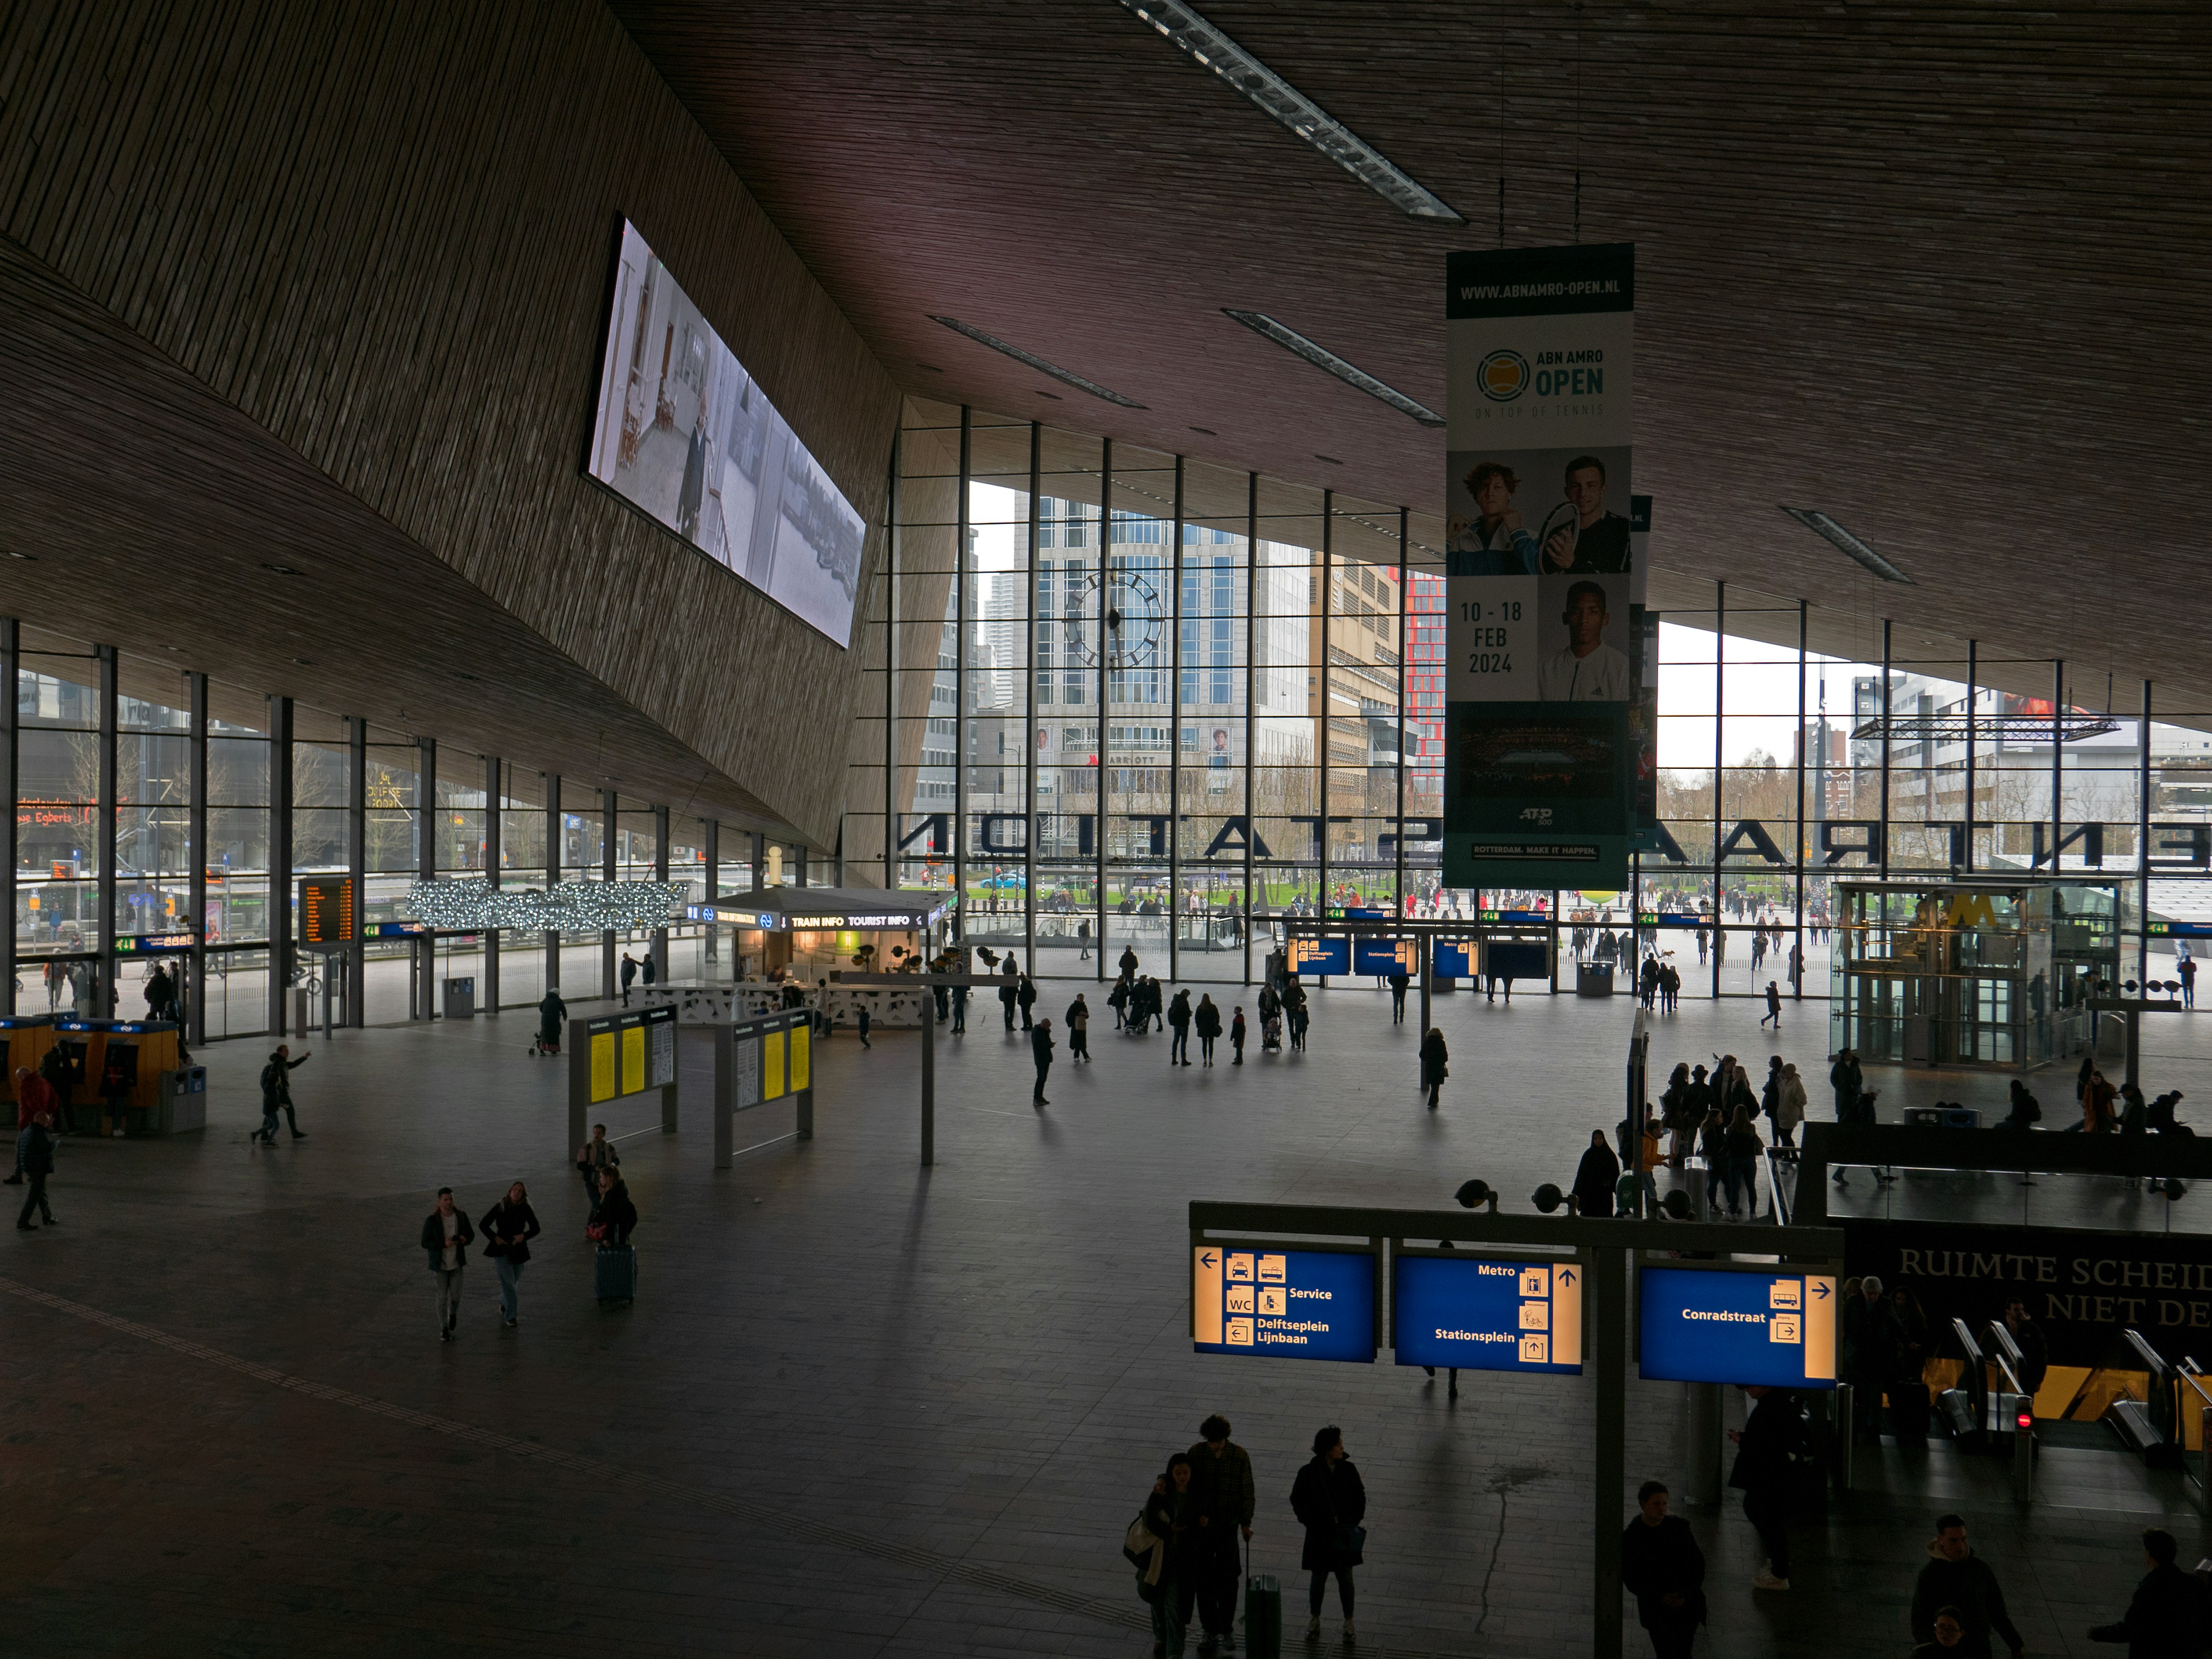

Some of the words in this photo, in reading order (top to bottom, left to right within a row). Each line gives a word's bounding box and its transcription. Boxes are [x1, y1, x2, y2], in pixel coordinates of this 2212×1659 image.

[1460, 280, 1621, 300] WWW.ABNAMRO-OPEN.NL
[1537, 352, 1563, 365] ABN
[1566, 350, 1603, 364] AMRO
[1536, 368, 1603, 397] OPEN
[1475, 409, 1491, 420] ON
[1501, 407, 1522, 419] TOP
[1532, 406, 1546, 417] OF
[1556, 404, 1603, 416] TENNIS
[1461, 603, 1481, 622] 10
[1502, 602, 1521, 621] 18
[1475, 628, 1507, 648] FEB
[1469, 653, 1512, 673] 2024
[35, 811, 72, 826] Egberts
[1519, 808, 1553, 819] ATP
[791, 917, 820, 927] TRAIN
[821, 916, 845, 927] INFO
[848, 916, 886, 926] TOURIST
[887, 915, 910, 925] INFO
[1478, 1265, 1516, 1277] Metro
[1899, 1248, 2058, 1283] RUIMTE
[1290, 1288, 1332, 1300] Service
[1230, 1299, 1251, 1311] WC
[2045, 1293, 2146, 1324] NIET
[2157, 1299, 2211, 1328] DE
[1682, 1309, 1766, 1323] Conradstraat
[1257, 1318, 1329, 1333] Delftseplein
[1257, 1332, 1308, 1345] Lijnbaan
[1435, 1328, 1515, 1344] Stationsplein
